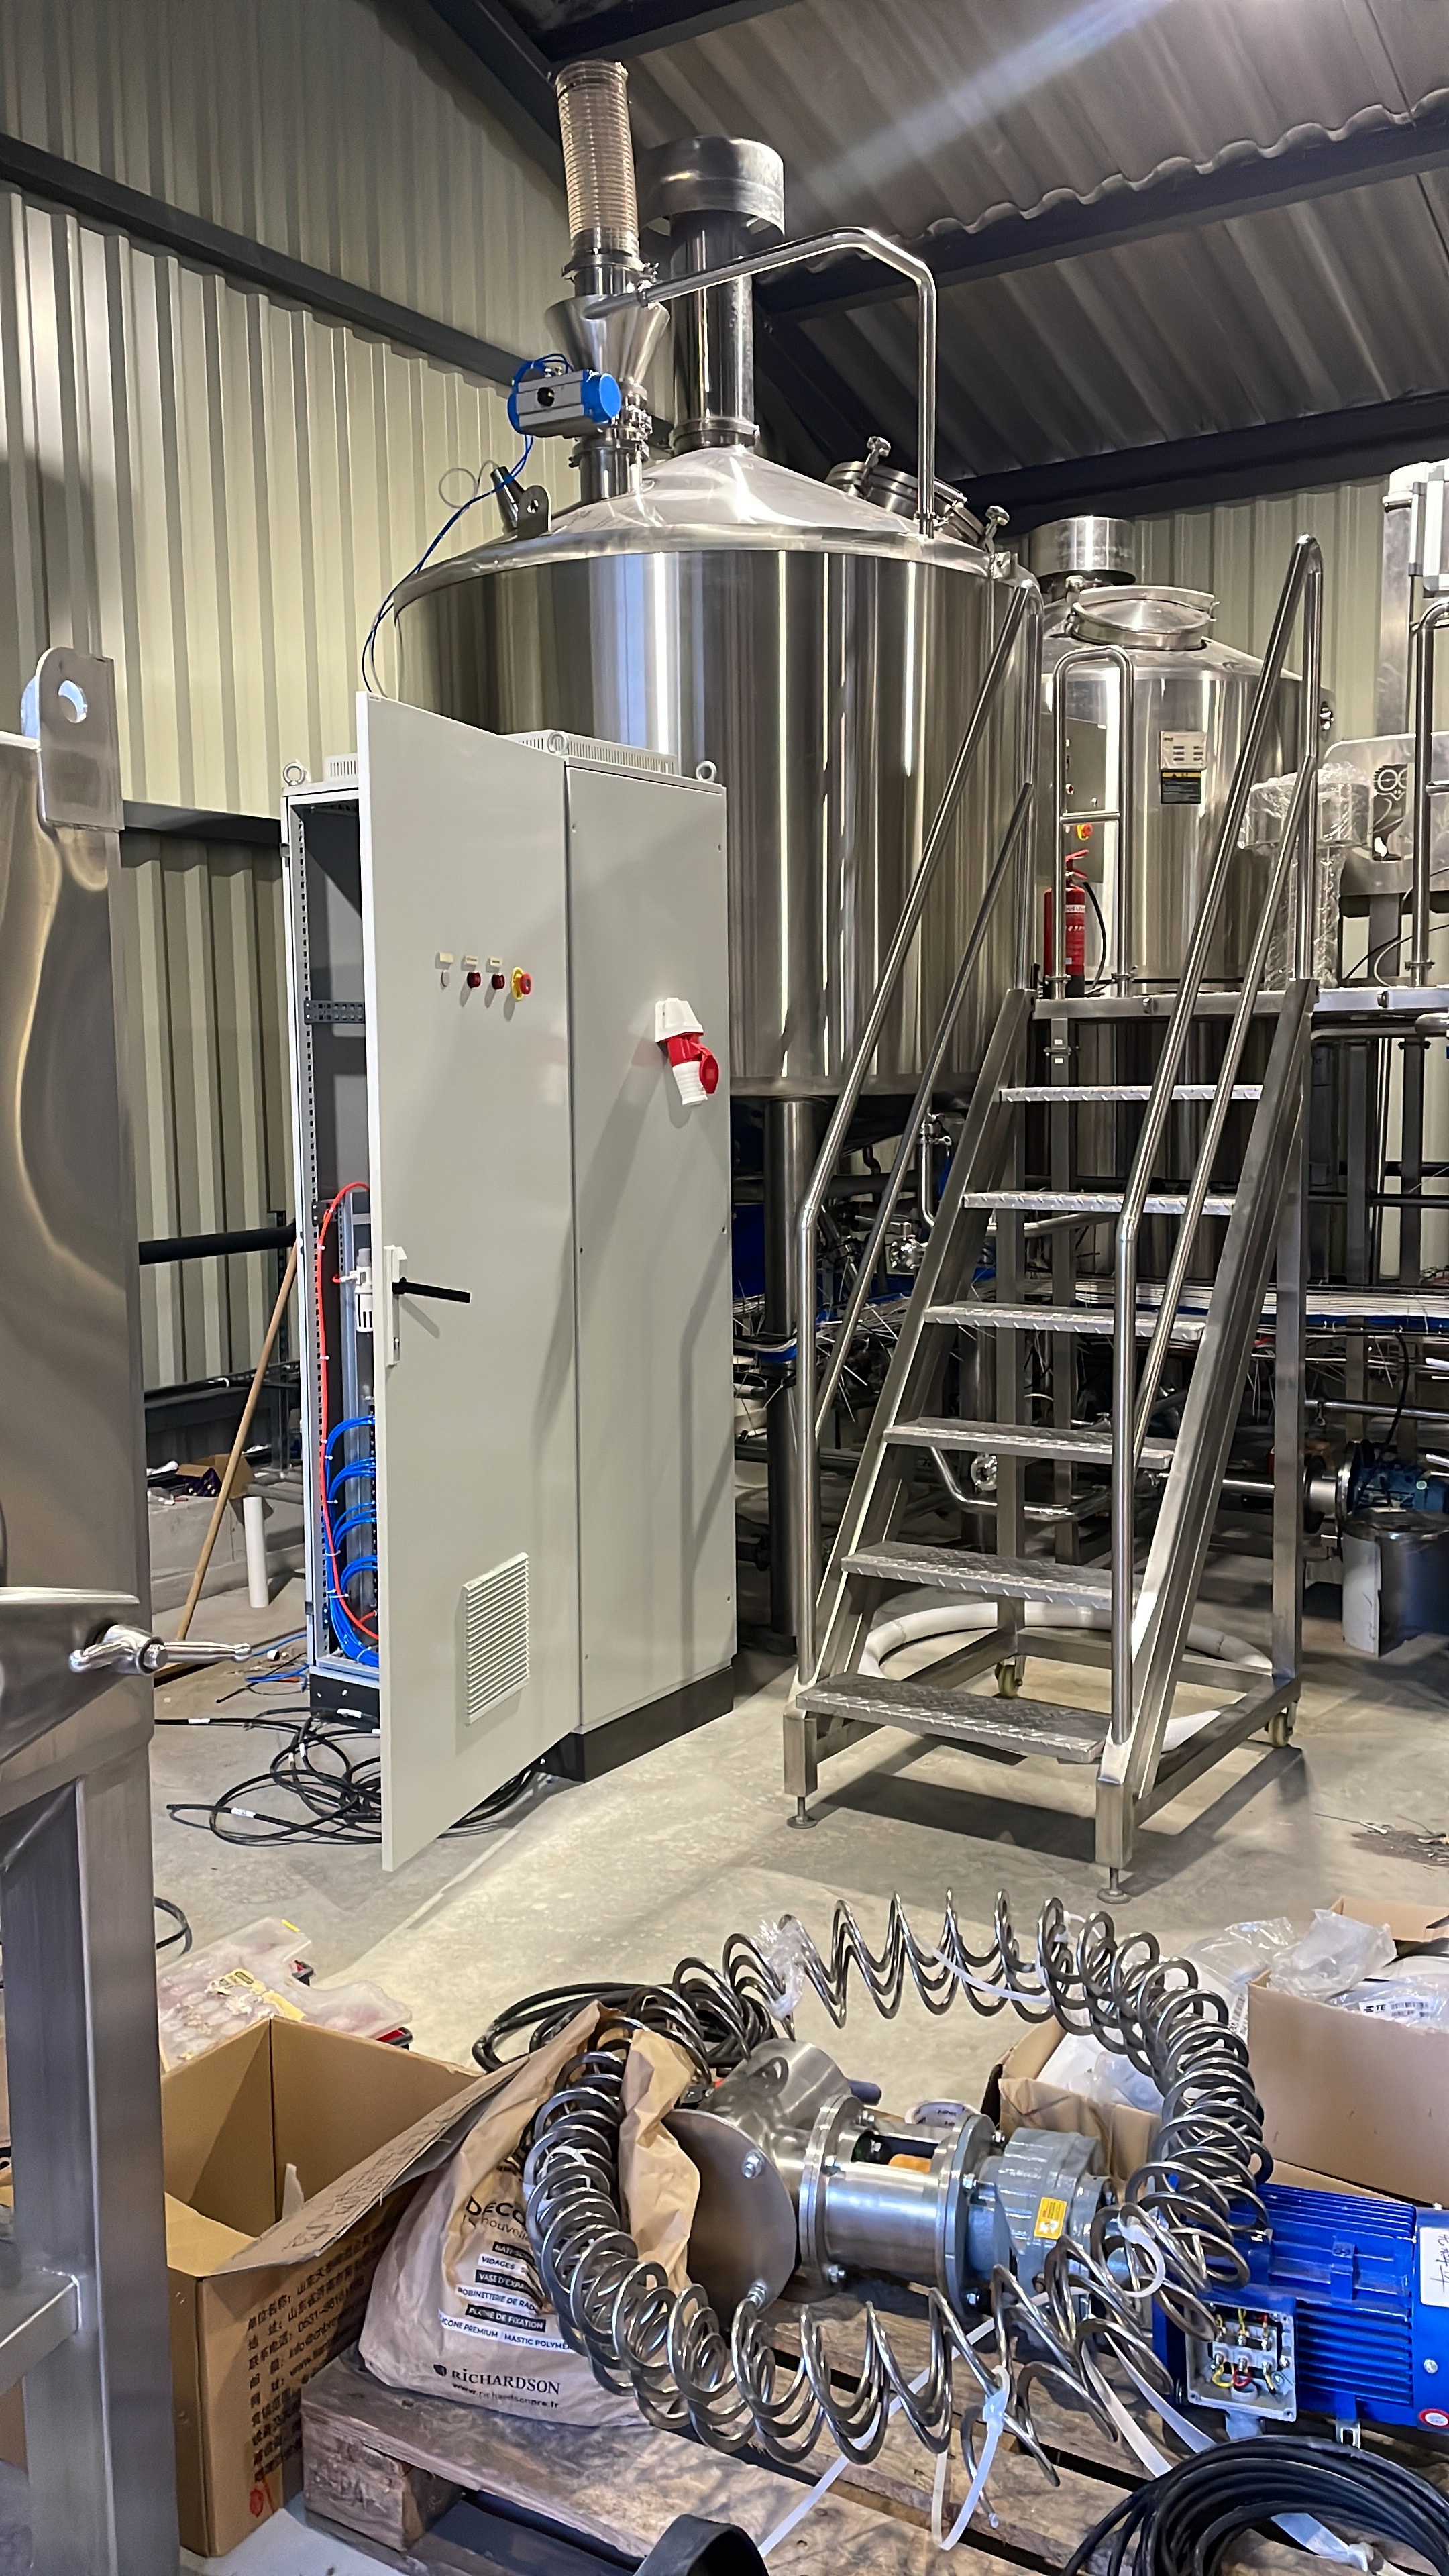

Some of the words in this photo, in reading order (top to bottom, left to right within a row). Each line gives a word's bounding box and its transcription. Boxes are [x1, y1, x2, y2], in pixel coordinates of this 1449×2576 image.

[482, 2256, 515, 2270] VIDAGES
[479, 2273, 497, 2283] VASE
[498, 2275, 526, 2290] D'EXPA
[458, 2286, 506, 2303] ROBINETTERIE
[506, 2297, 518, 2305] DE
[496, 2313, 508, 2322] DE
[508, 2316, 543, 2330] FIXATION
[464, 2324, 498, 2338] PREMIUM
[504, 2334, 533, 2345] MASTIC
